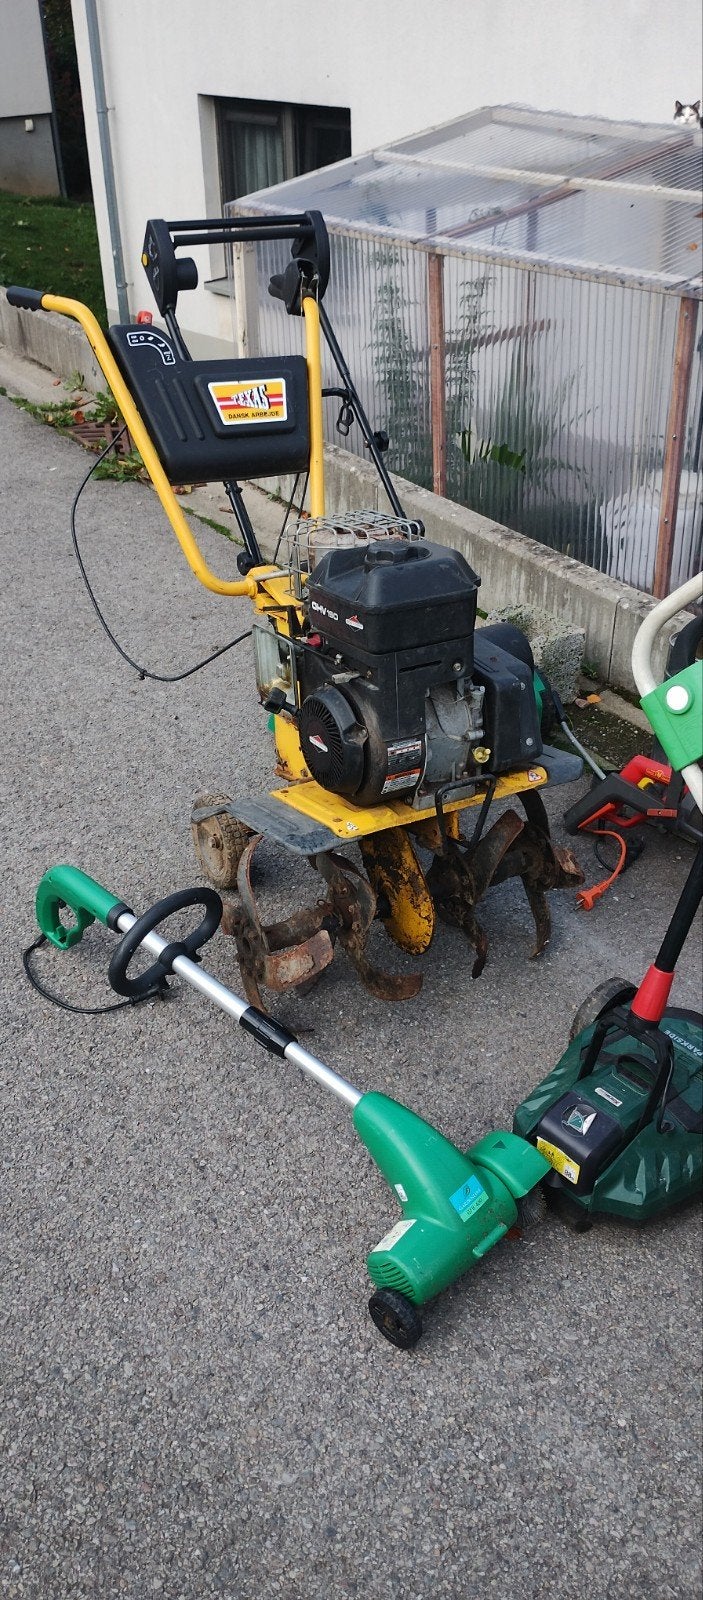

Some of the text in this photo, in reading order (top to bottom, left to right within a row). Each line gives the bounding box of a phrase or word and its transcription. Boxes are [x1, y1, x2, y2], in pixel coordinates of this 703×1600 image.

[231, 384, 270, 410] TEXAS
[228, 410, 280, 420] DANSK ARBEJDE
[664, 1029, 703, 1057] PARKSIDE
